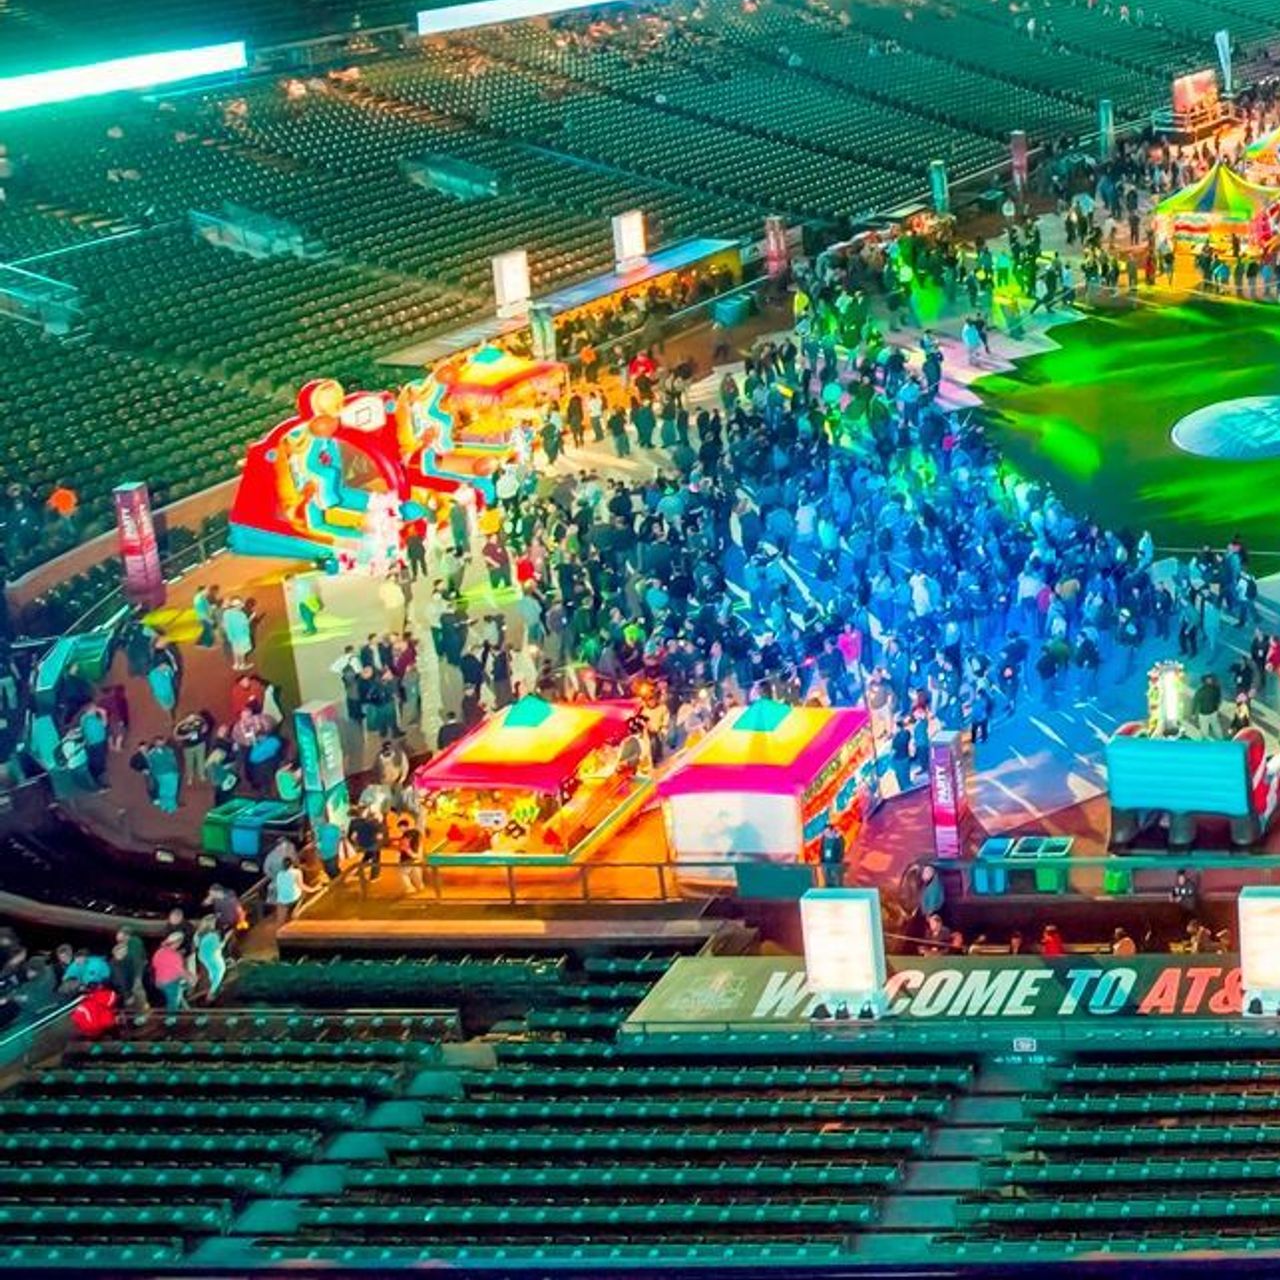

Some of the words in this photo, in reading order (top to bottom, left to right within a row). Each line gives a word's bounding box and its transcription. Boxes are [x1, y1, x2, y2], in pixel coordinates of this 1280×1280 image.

[935, 764, 952, 805] PARTY
[752, 968, 1056, 1018] WCOME
[1057, 967, 1139, 1017] TO
[1137, 966, 1248, 1015] AT&
